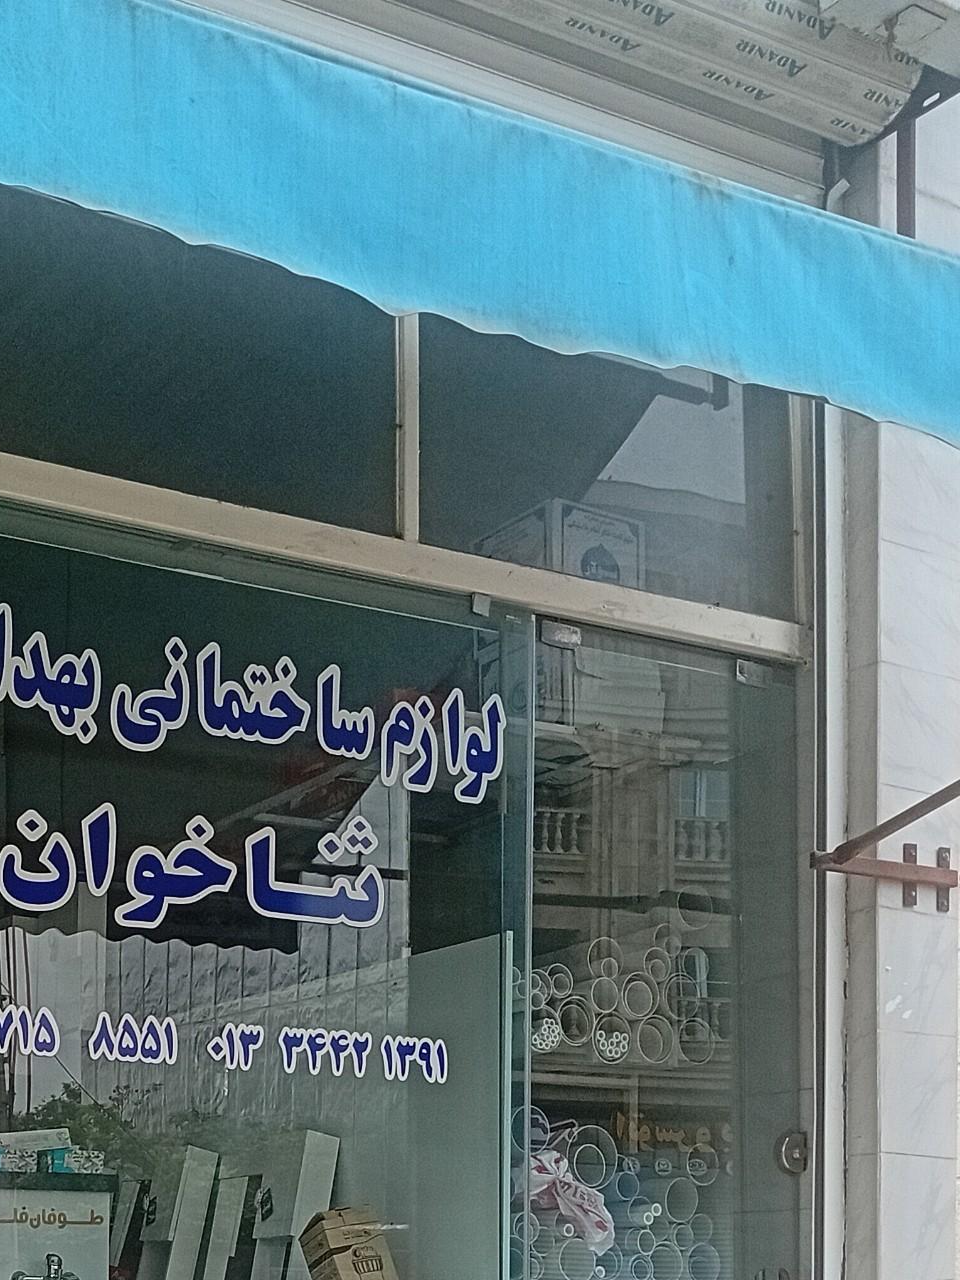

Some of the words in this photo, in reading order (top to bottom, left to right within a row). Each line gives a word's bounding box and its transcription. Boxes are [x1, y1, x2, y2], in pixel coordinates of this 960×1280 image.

[609, 0, 674, 27] ADAN
[764, 0, 837, 40] ADANIR
[565, 17, 640, 52] ADANIR
[735, 39, 808, 78] ADANIR
[702, 69, 775, 101] ADANIR
[111, 636, 375, 762] ساختمانی
[380, 688, 506, 805] لوازم
[88, 1011, 178, 1064] ۸۵۵۱
[206, 1020, 265, 1072] ۰۱۳
[279, 1024, 372, 1077] ۳۴۴۲
[381, 1032, 449, 1084] ۱۳۹۱
[29, 1207, 105, 1229] طوفان
